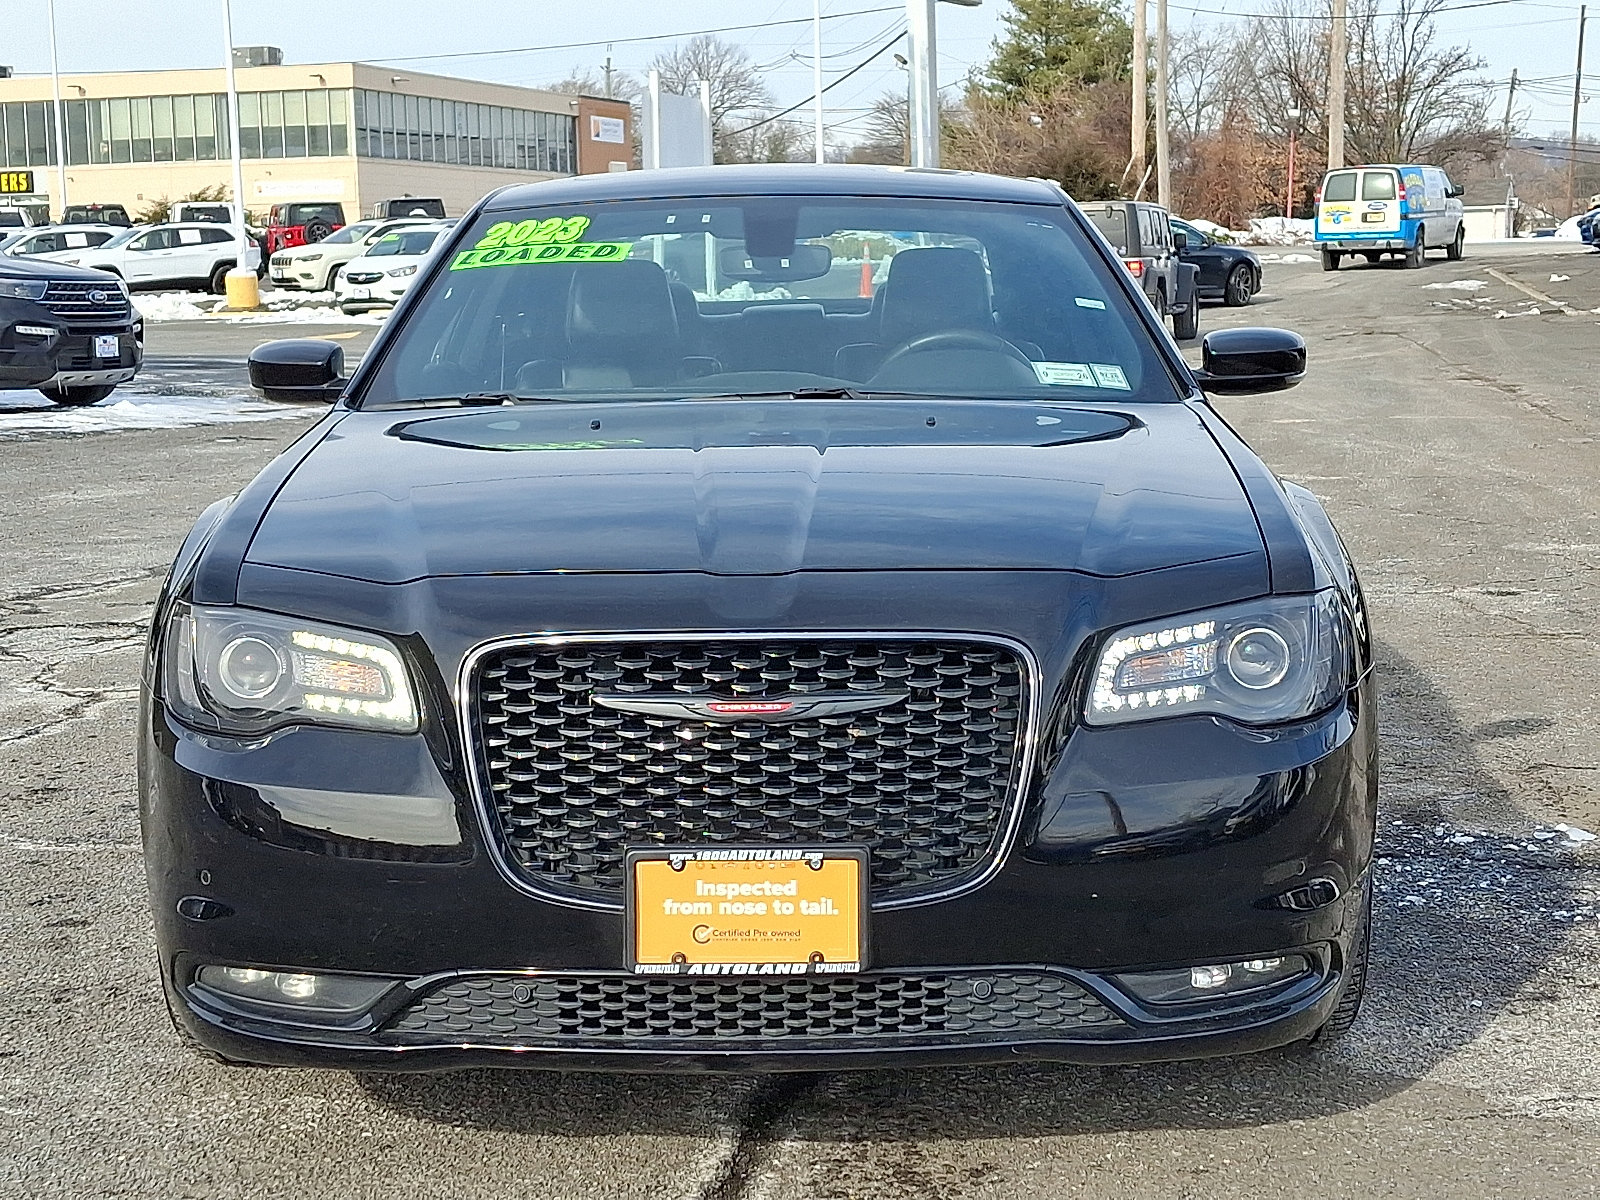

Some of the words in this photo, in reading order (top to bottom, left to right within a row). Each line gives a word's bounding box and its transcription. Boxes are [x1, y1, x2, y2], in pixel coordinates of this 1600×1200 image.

[1, 173, 28, 192] ERS
[475, 215, 591, 250] 2023
[458, 244, 620, 266] LOADED
[696, 880, 798, 900] Inspected
[663, 898, 713, 915] from
[719, 901, 768, 915] nose
[772, 900, 795, 915] to
[800, 897, 839, 915] tail.
[712, 929, 751, 937] Certified
[686, 963, 809, 975] AUTOLAND
